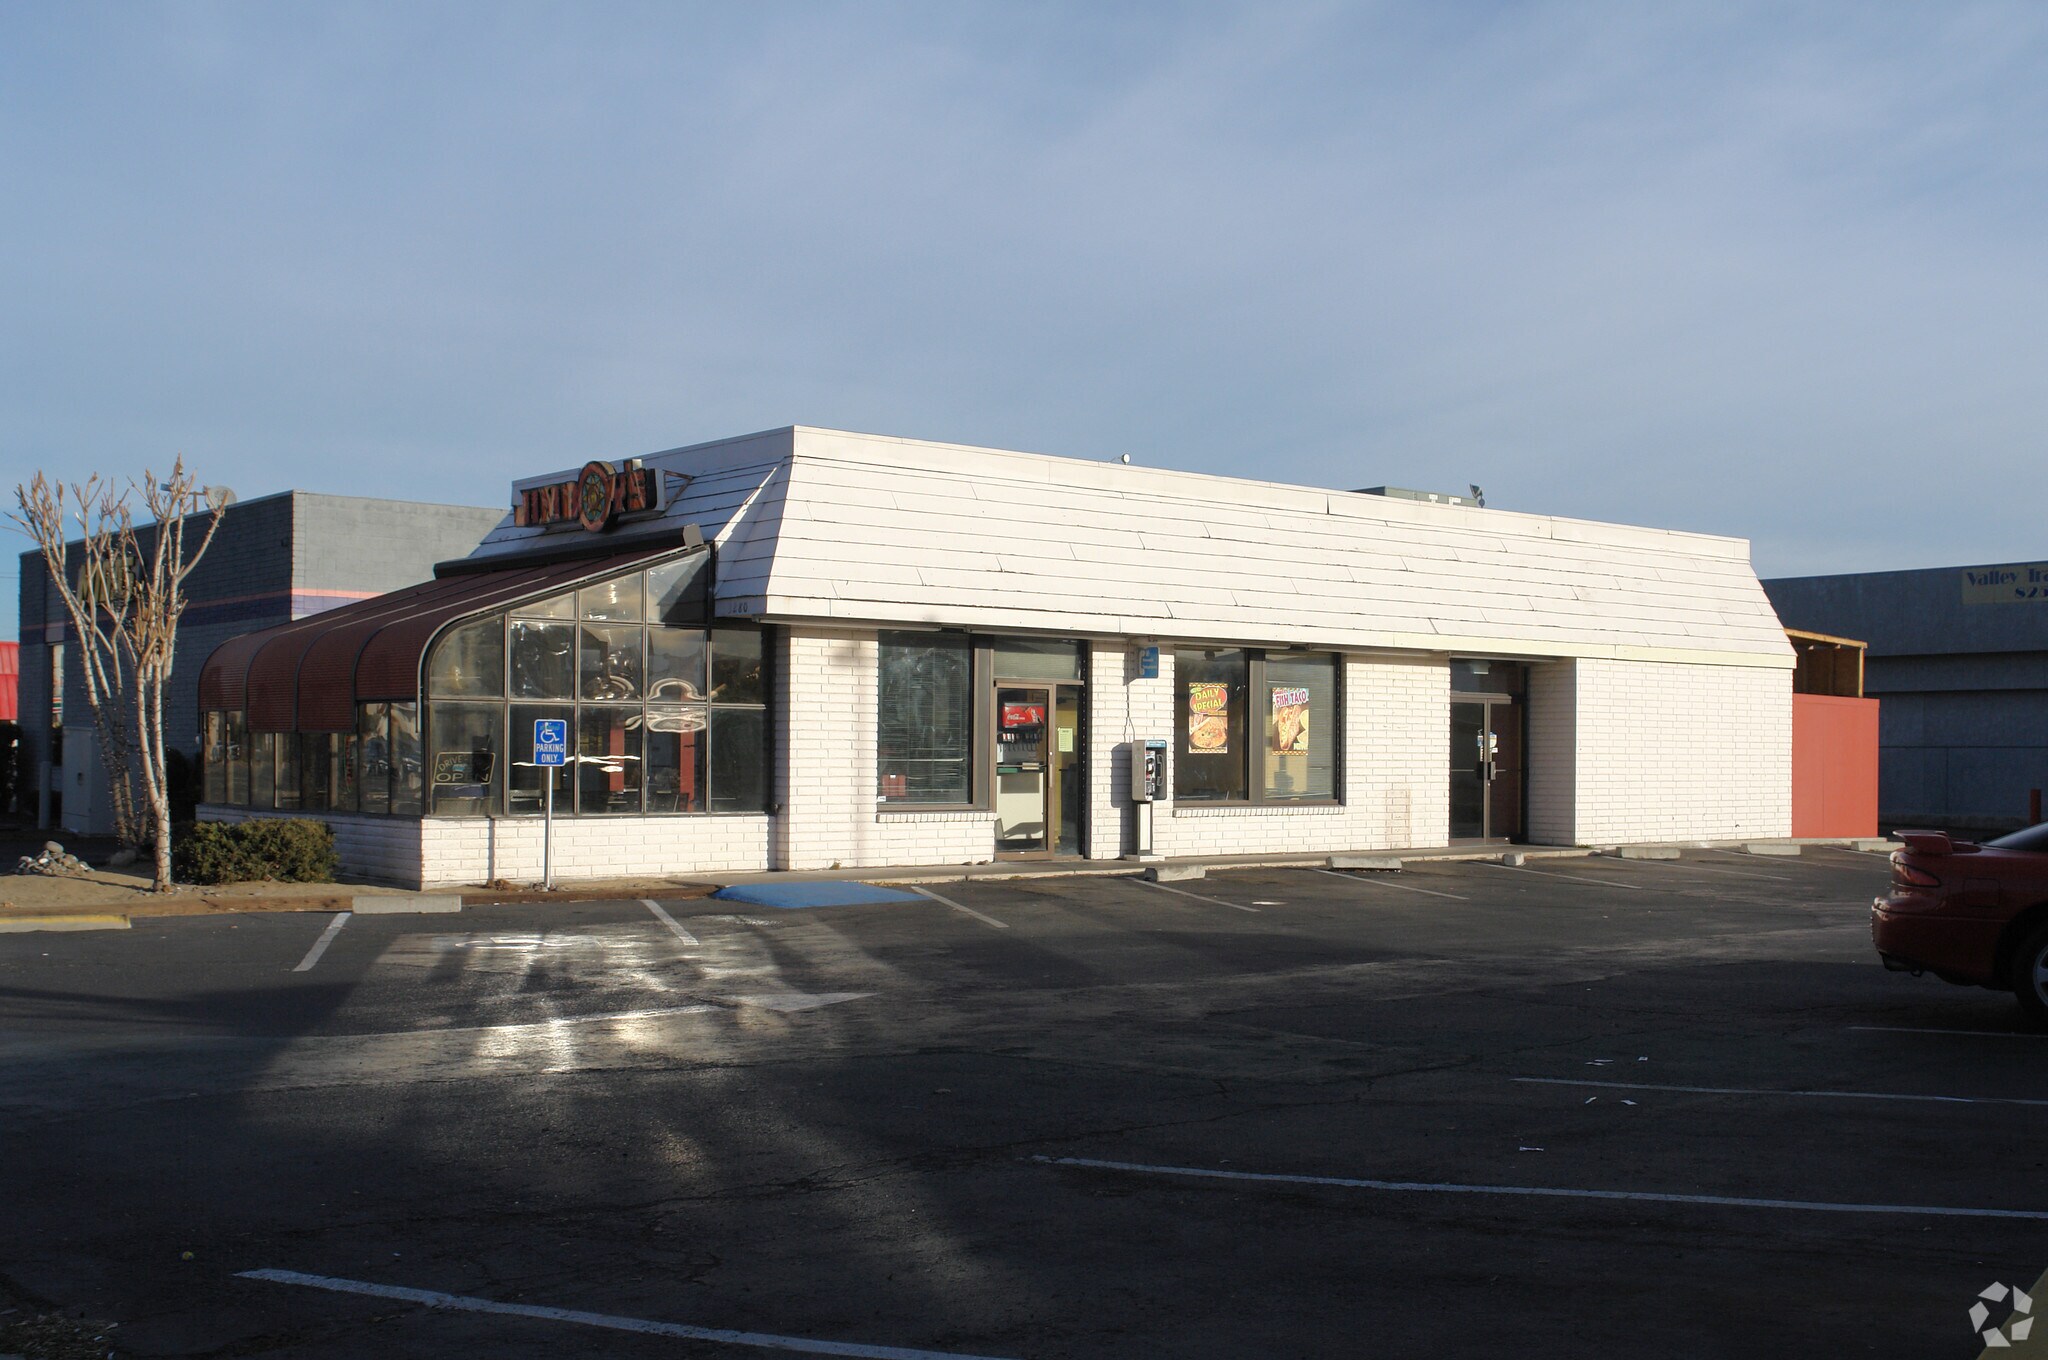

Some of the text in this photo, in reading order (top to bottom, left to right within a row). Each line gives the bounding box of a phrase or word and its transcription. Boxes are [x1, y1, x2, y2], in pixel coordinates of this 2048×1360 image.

[1967, 571, 2018, 586] Valley
[1195, 688, 1219, 700] DAILY
[1276, 694, 1290, 706] FISH
[1290, 690, 1307, 704] TACO
[1194, 698, 1222, 712] SPECIAL
[536, 743, 564, 753] PARKING
[541, 753, 558, 763] ONLY
